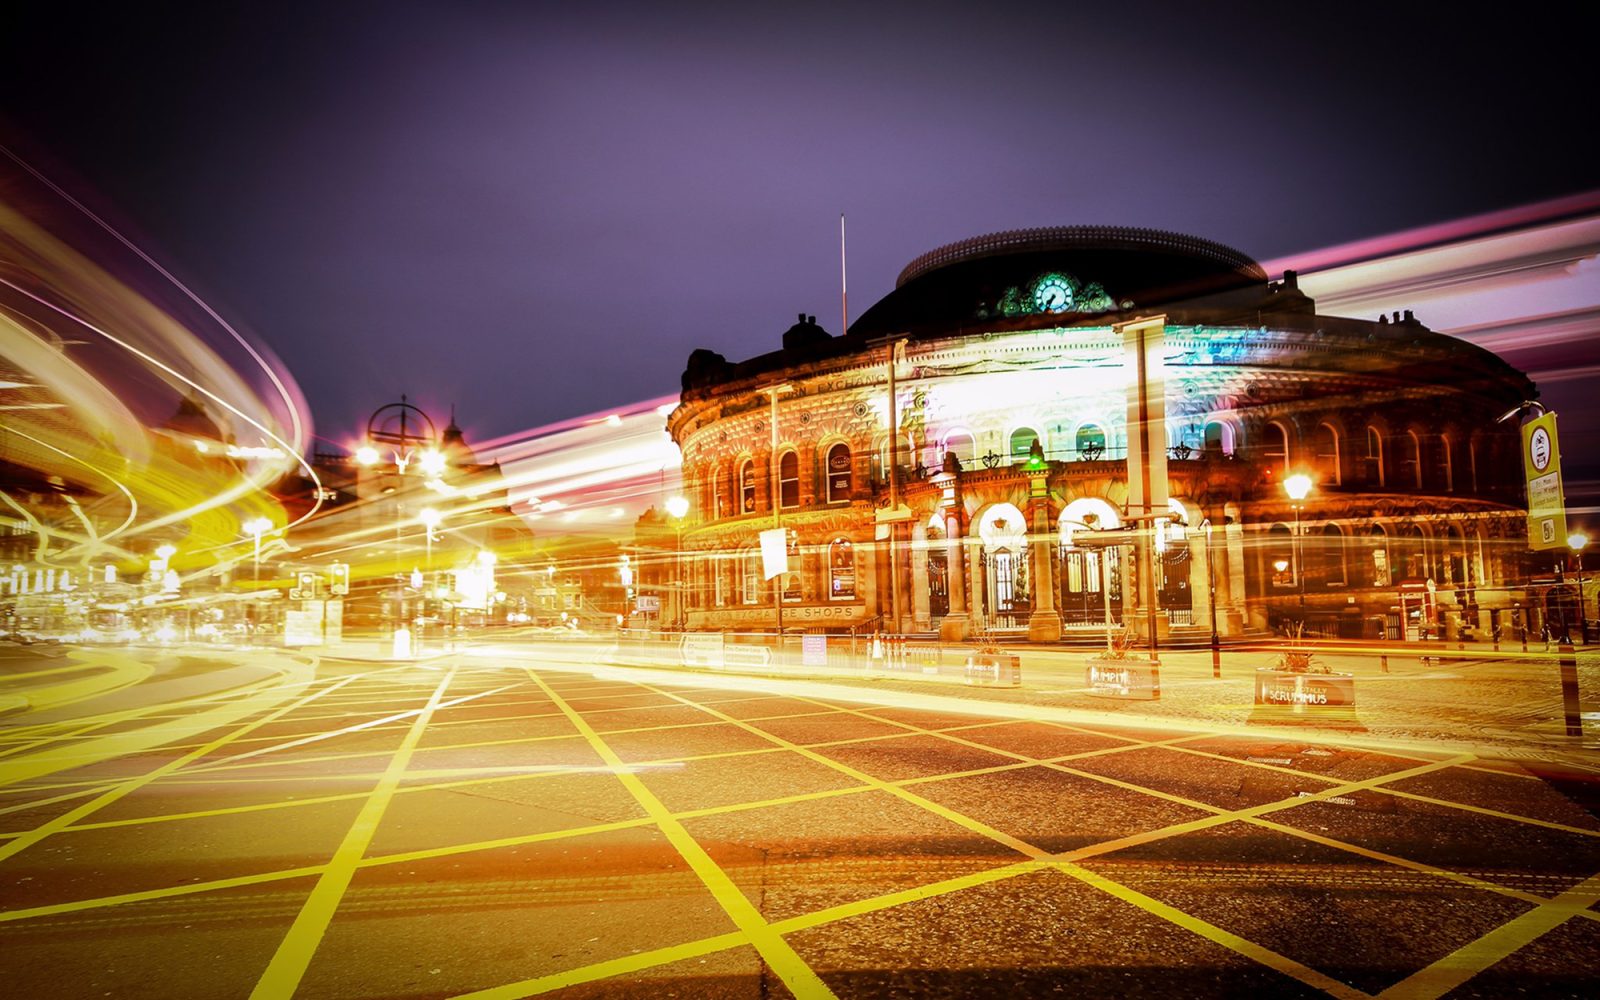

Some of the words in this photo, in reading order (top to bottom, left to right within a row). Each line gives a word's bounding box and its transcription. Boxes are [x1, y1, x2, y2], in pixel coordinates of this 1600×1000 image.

[817, 374, 887, 394] EXCHANG
[736, 608, 797, 620] EXCHAGE
[804, 607, 854, 618] SHOPS
[1269, 690, 1327, 705] SCRUMMUS
